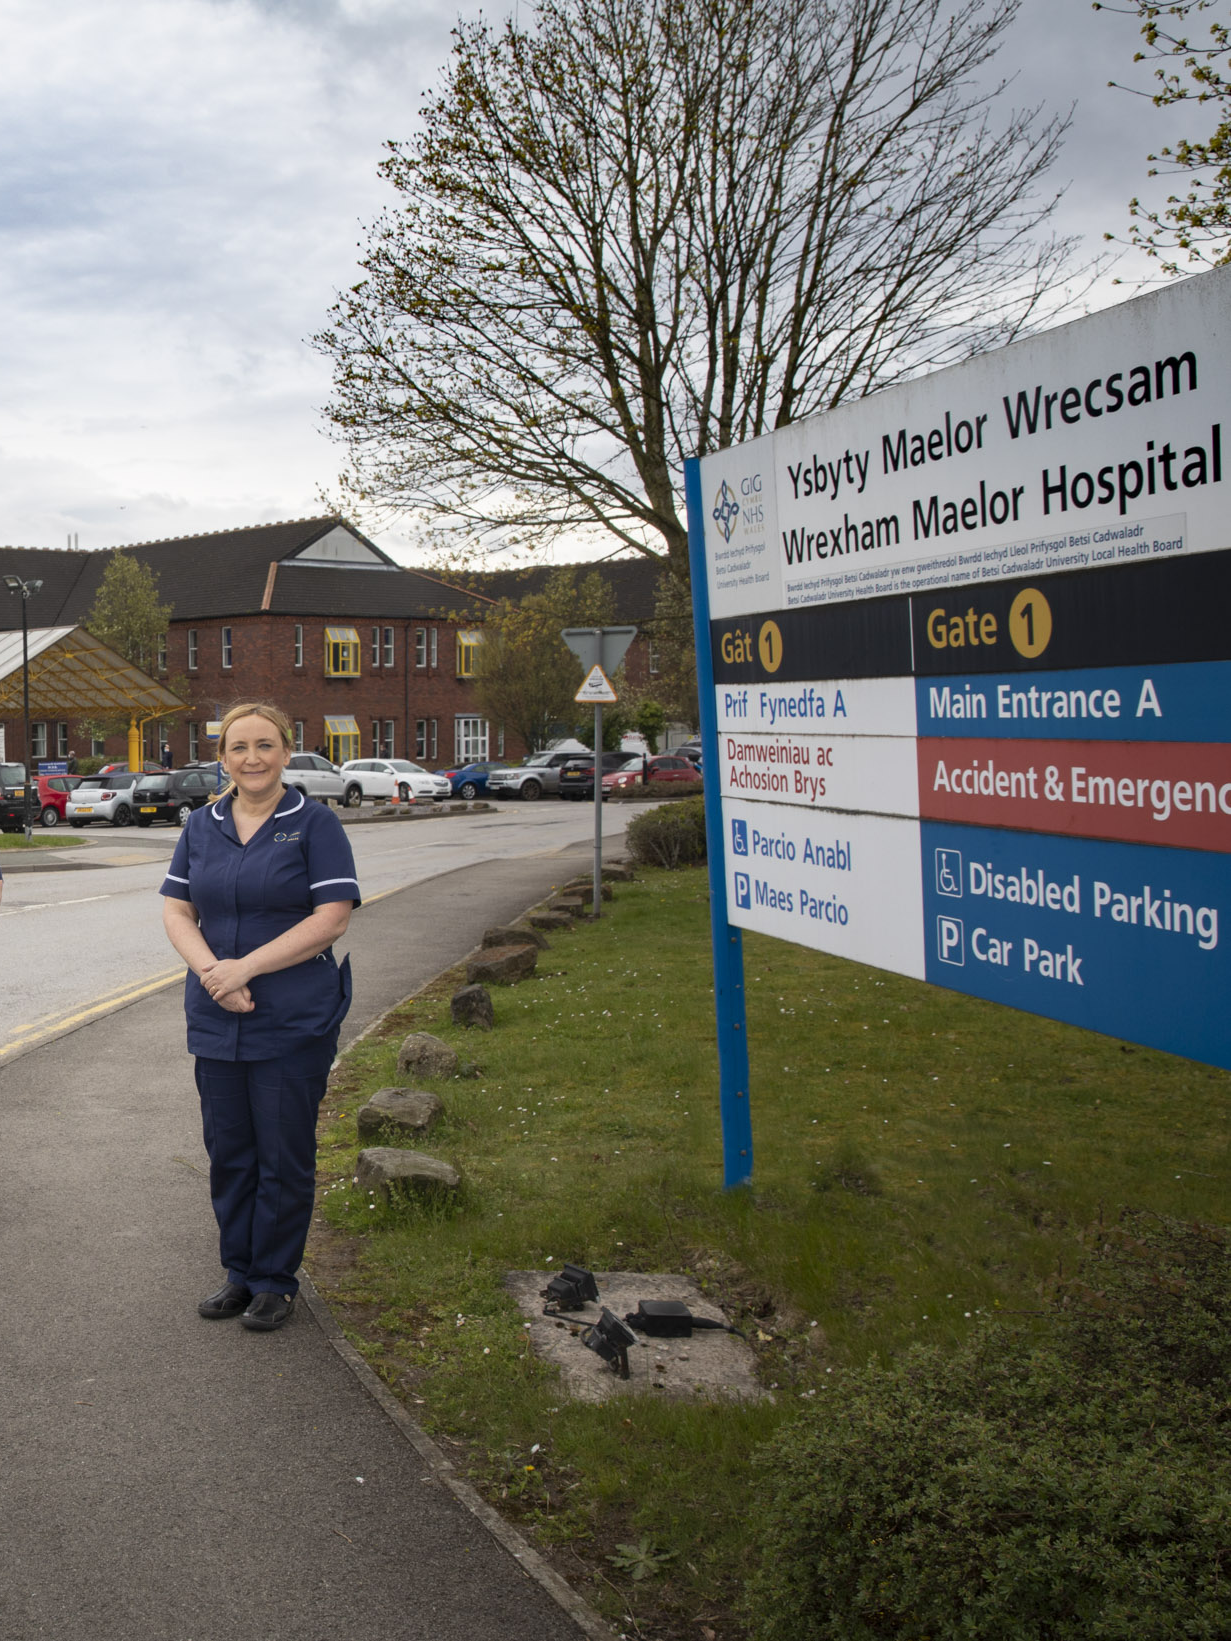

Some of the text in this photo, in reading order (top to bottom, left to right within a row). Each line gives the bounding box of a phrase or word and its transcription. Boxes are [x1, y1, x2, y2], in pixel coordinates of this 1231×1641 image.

[787, 351, 1197, 500] Ysbyty Maelor Wrecsam
[741, 474, 762, 495] GIG
[782, 423, 1221, 565] Wrexham Maelor Hospital
[743, 504, 764, 526] NHS
[744, 523, 765, 536] WALES
[787, 582, 803, 593] Bwrdd
[821, 574, 844, 591] Prifysgol
[844, 572, 858, 584] Betsi
[859, 569, 890, 582] Cadwaladr
[891, 567, 901, 578] yw
[901, 565, 915, 575] enw
[917, 556, 957, 574] gweithredol
[958, 551, 982, 566] Bwrdd
[983, 546, 1009, 564] Iechyd
[1009, 543, 1029, 558] Lleol
[1030, 536, 1067, 556] Prifysgol
[1069, 532, 1091, 548] Betsi
[1093, 524, 1144, 544] Cadwaladr
[788, 594, 799, 606] Betsi
[800, 590, 827, 604] Cadwaladr
[827, 587, 855, 601] University
[855, 584, 874, 596] Health
[875, 581, 893, 593] Board
[900, 578, 911, 589] the
[912, 573, 950, 590] operational
[951, 571, 970, 583] name
[972, 566, 980, 578] of
[981, 563, 1000, 577] Betsi
[1001, 558, 1044, 575] Cadwaladr
[1045, 551, 1089, 569] University
[1091, 545, 1115, 561] Local
[1118, 540, 1150, 557] Health
[1152, 536, 1183, 552] Board
[717, 571, 770, 591] University Health Board
[721, 629, 753, 664] Gât
[927, 607, 998, 649] Gate
[725, 688, 847, 725] Prif Fynedfa A
[929, 678, 1162, 718] Main Entrance A
[727, 738, 833, 767] Damweiniau ac
[730, 765, 826, 802] Achosion Brys
[933, 760, 1231, 821] Accident & Emergenc
[752, 829, 851, 871] Parcio Anabl
[755, 879, 793, 912] Maes
[800, 889, 848, 926] Parcio
[969, 861, 1218, 950] Disabled Parking
[941, 920, 1084, 986] P Car Park
